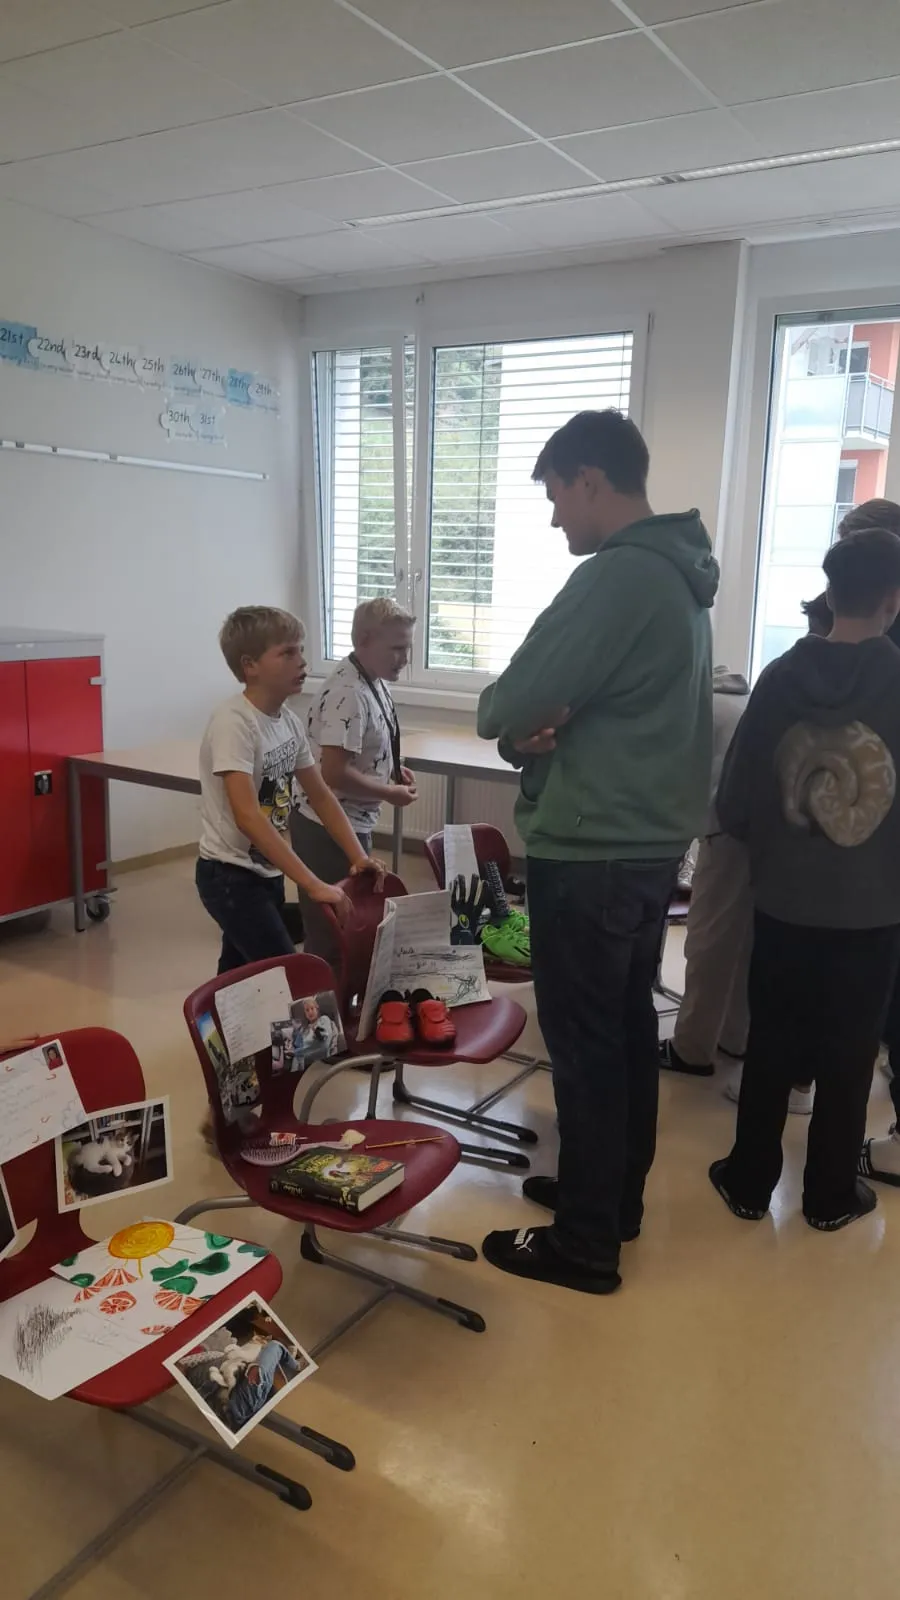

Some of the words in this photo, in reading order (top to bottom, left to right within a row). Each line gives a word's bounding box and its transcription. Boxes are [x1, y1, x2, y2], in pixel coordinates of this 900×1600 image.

[0, 327, 24, 345] 21st
[37, 337, 64, 354] 22nd
[74, 344, 99, 361] 23rd
[142, 358, 164, 373] 25th
[201, 368, 221, 384] 27th
[168, 407, 190, 424] 30th
[200, 412, 216, 425] 31st
